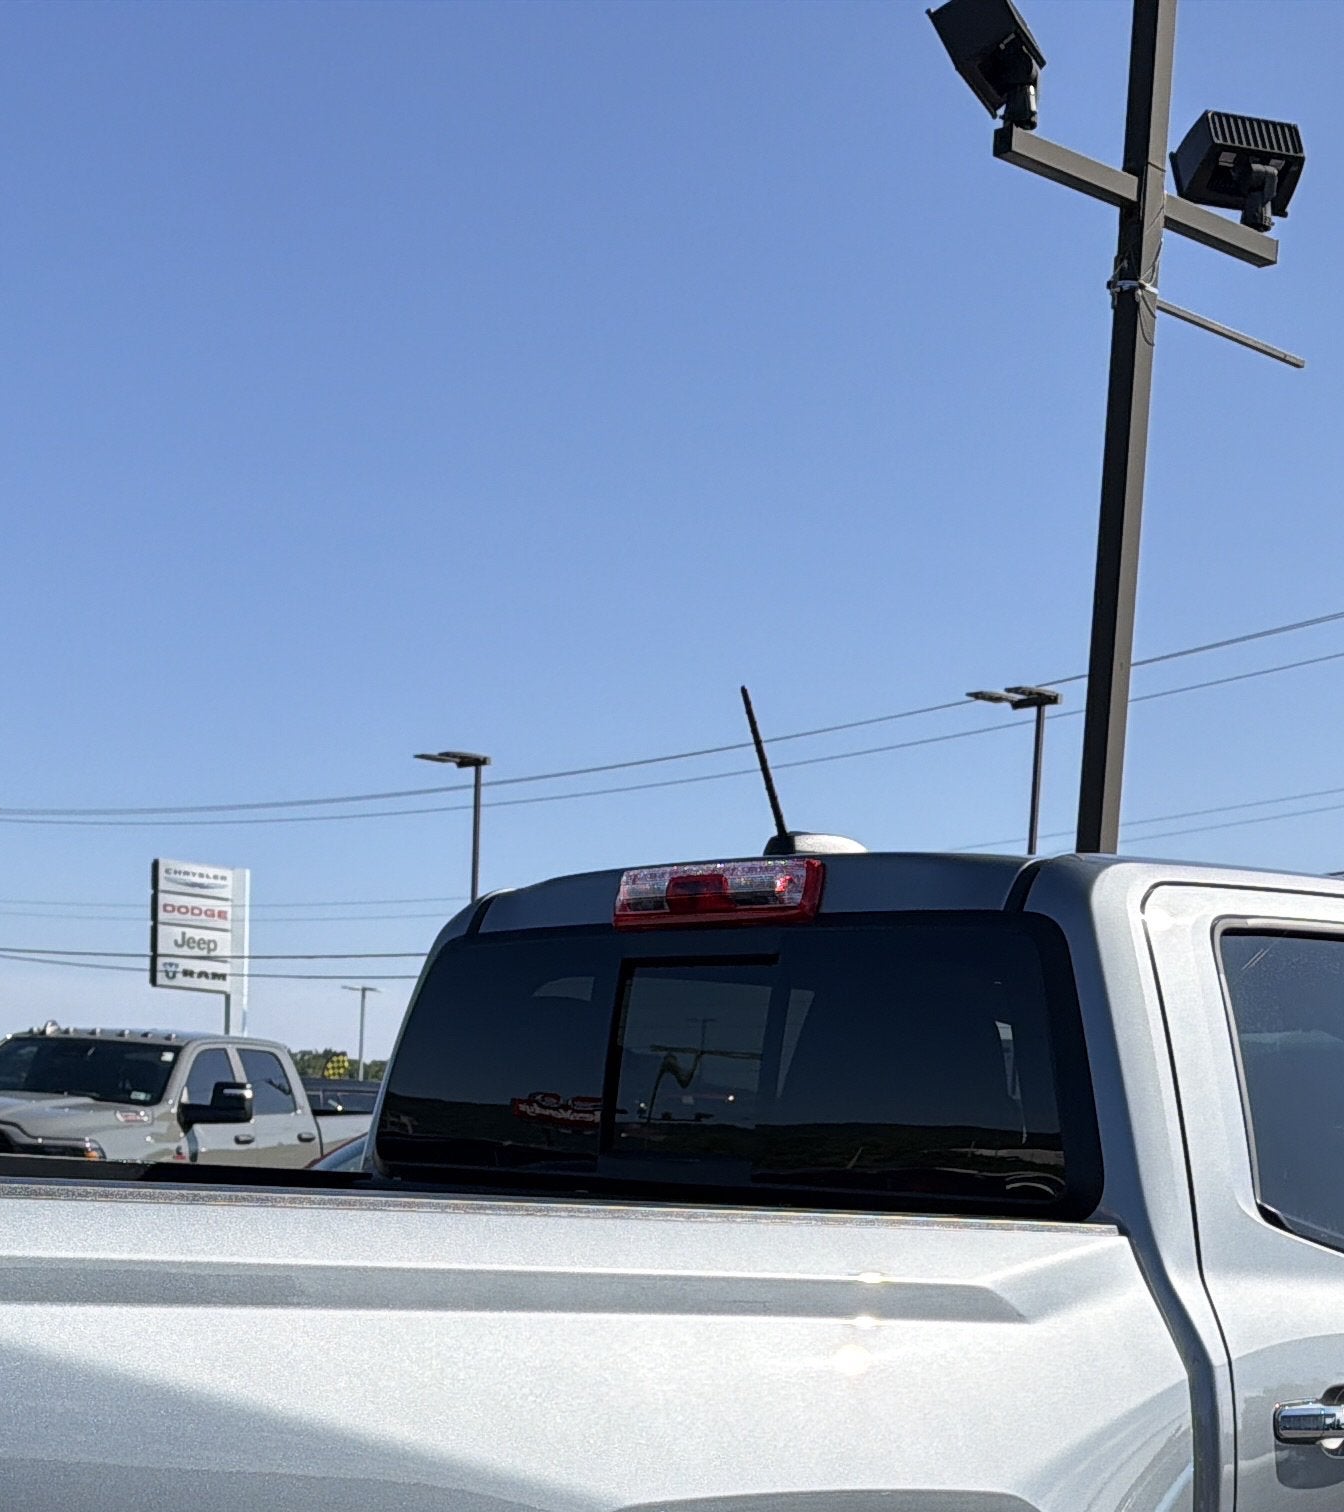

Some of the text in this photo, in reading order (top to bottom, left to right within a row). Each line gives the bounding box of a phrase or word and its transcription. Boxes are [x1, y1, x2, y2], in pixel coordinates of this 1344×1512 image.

[164, 868, 228, 882] CHRYSLER
[162, 903, 228, 921] DODGE
[173, 931, 218, 955] Jeep
[181, 968, 227, 982] RAM
